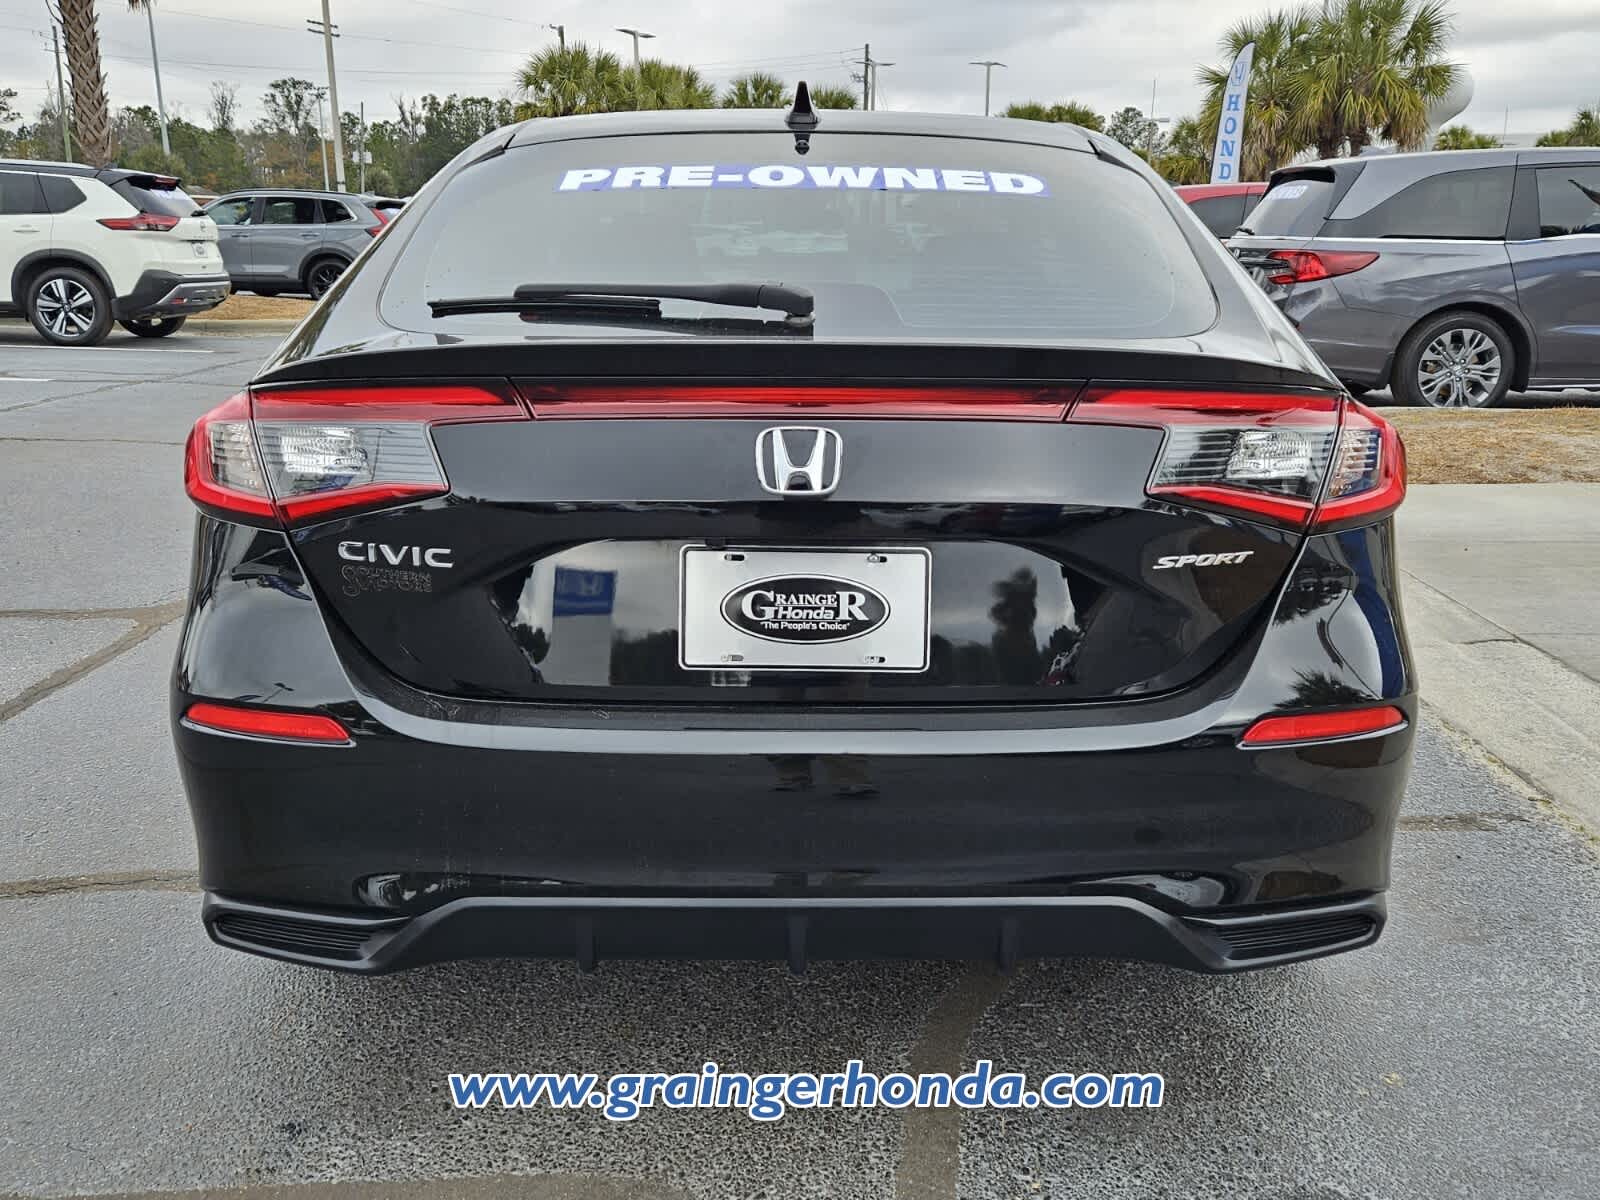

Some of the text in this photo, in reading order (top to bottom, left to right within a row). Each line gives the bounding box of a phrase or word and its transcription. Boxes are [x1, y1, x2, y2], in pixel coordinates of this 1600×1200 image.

[1217, 93, 1242, 180] HOND
[558, 164, 1045, 195] PRE-OWNED
[337, 540, 454, 569] CIVIC
[1152, 550, 1255, 570] SPORT
[741, 590, 870, 621] GRAINGER
[777, 606, 835, 620] Honda
[780, 621, 818, 632] People's
